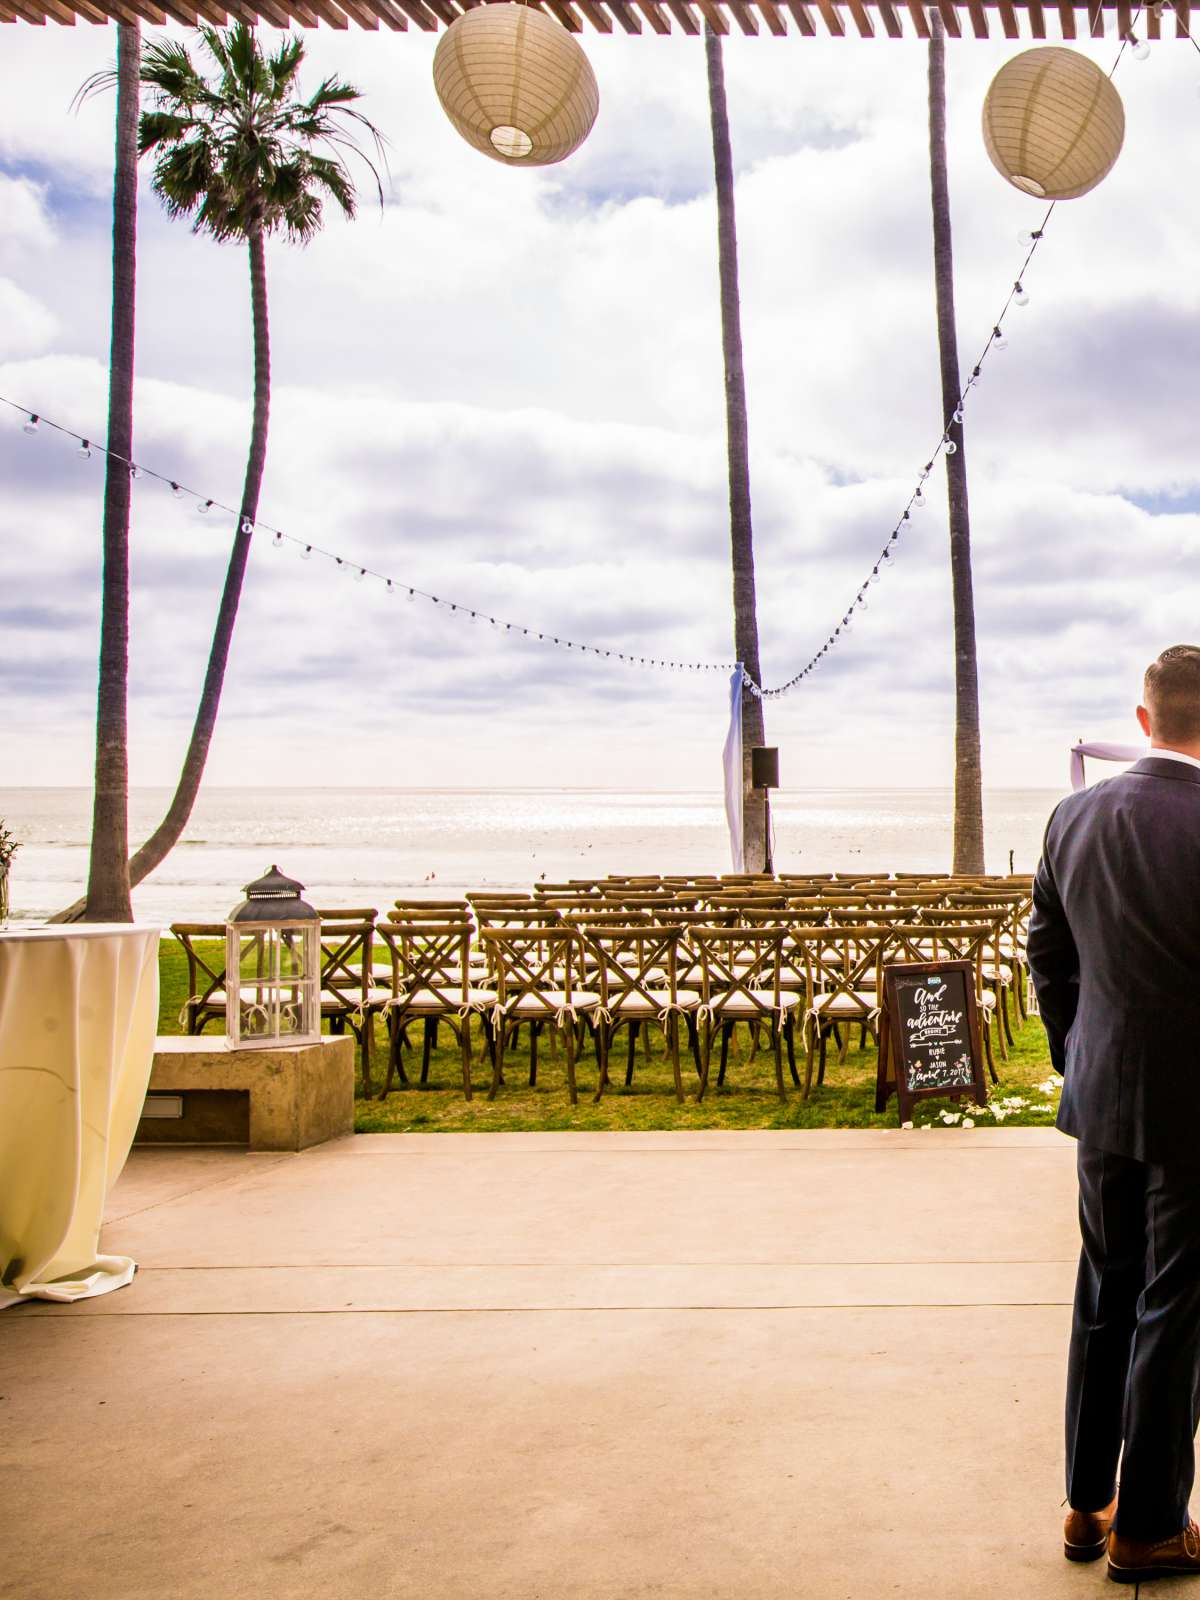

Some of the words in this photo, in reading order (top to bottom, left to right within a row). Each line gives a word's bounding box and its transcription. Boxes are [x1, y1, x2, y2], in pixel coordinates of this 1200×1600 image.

[907, 1010, 963, 1029] adventure
[928, 1047, 945, 1055] RUBIE
[929, 1061, 947, 1069] JASON
[950, 1068, 965, 1076] 2017
